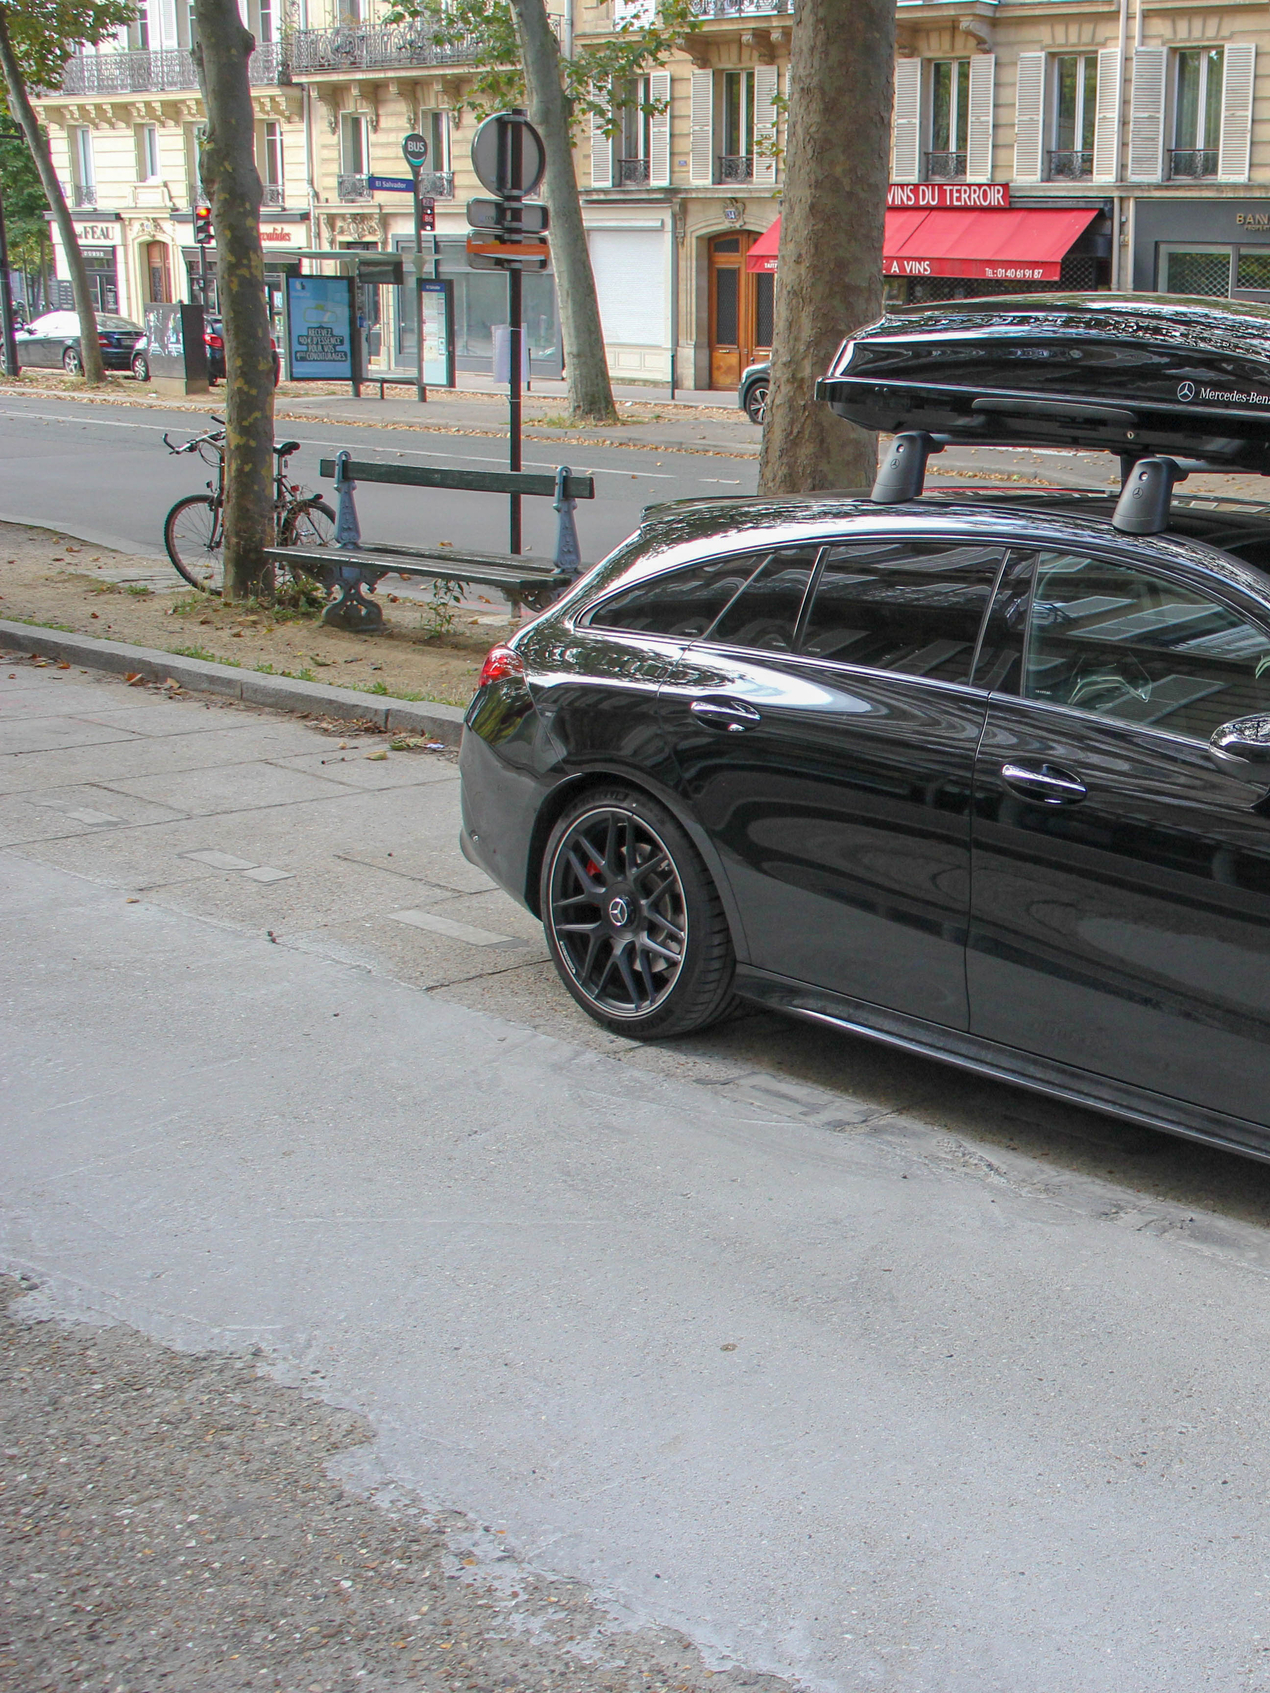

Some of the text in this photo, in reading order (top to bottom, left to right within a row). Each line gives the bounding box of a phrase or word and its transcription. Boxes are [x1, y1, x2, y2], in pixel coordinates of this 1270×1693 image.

[407, 141, 425, 152] BUS
[382, 180, 407, 189] Salvador
[887, 184, 1005, 206] VINS DU TERROIR
[890, 260, 900, 274] A
[904, 261, 931, 275] VINS
[1006, 269, 1016, 278] 40
[1016, 269, 1025, 279] 61
[1033, 269, 1043, 279] 87
